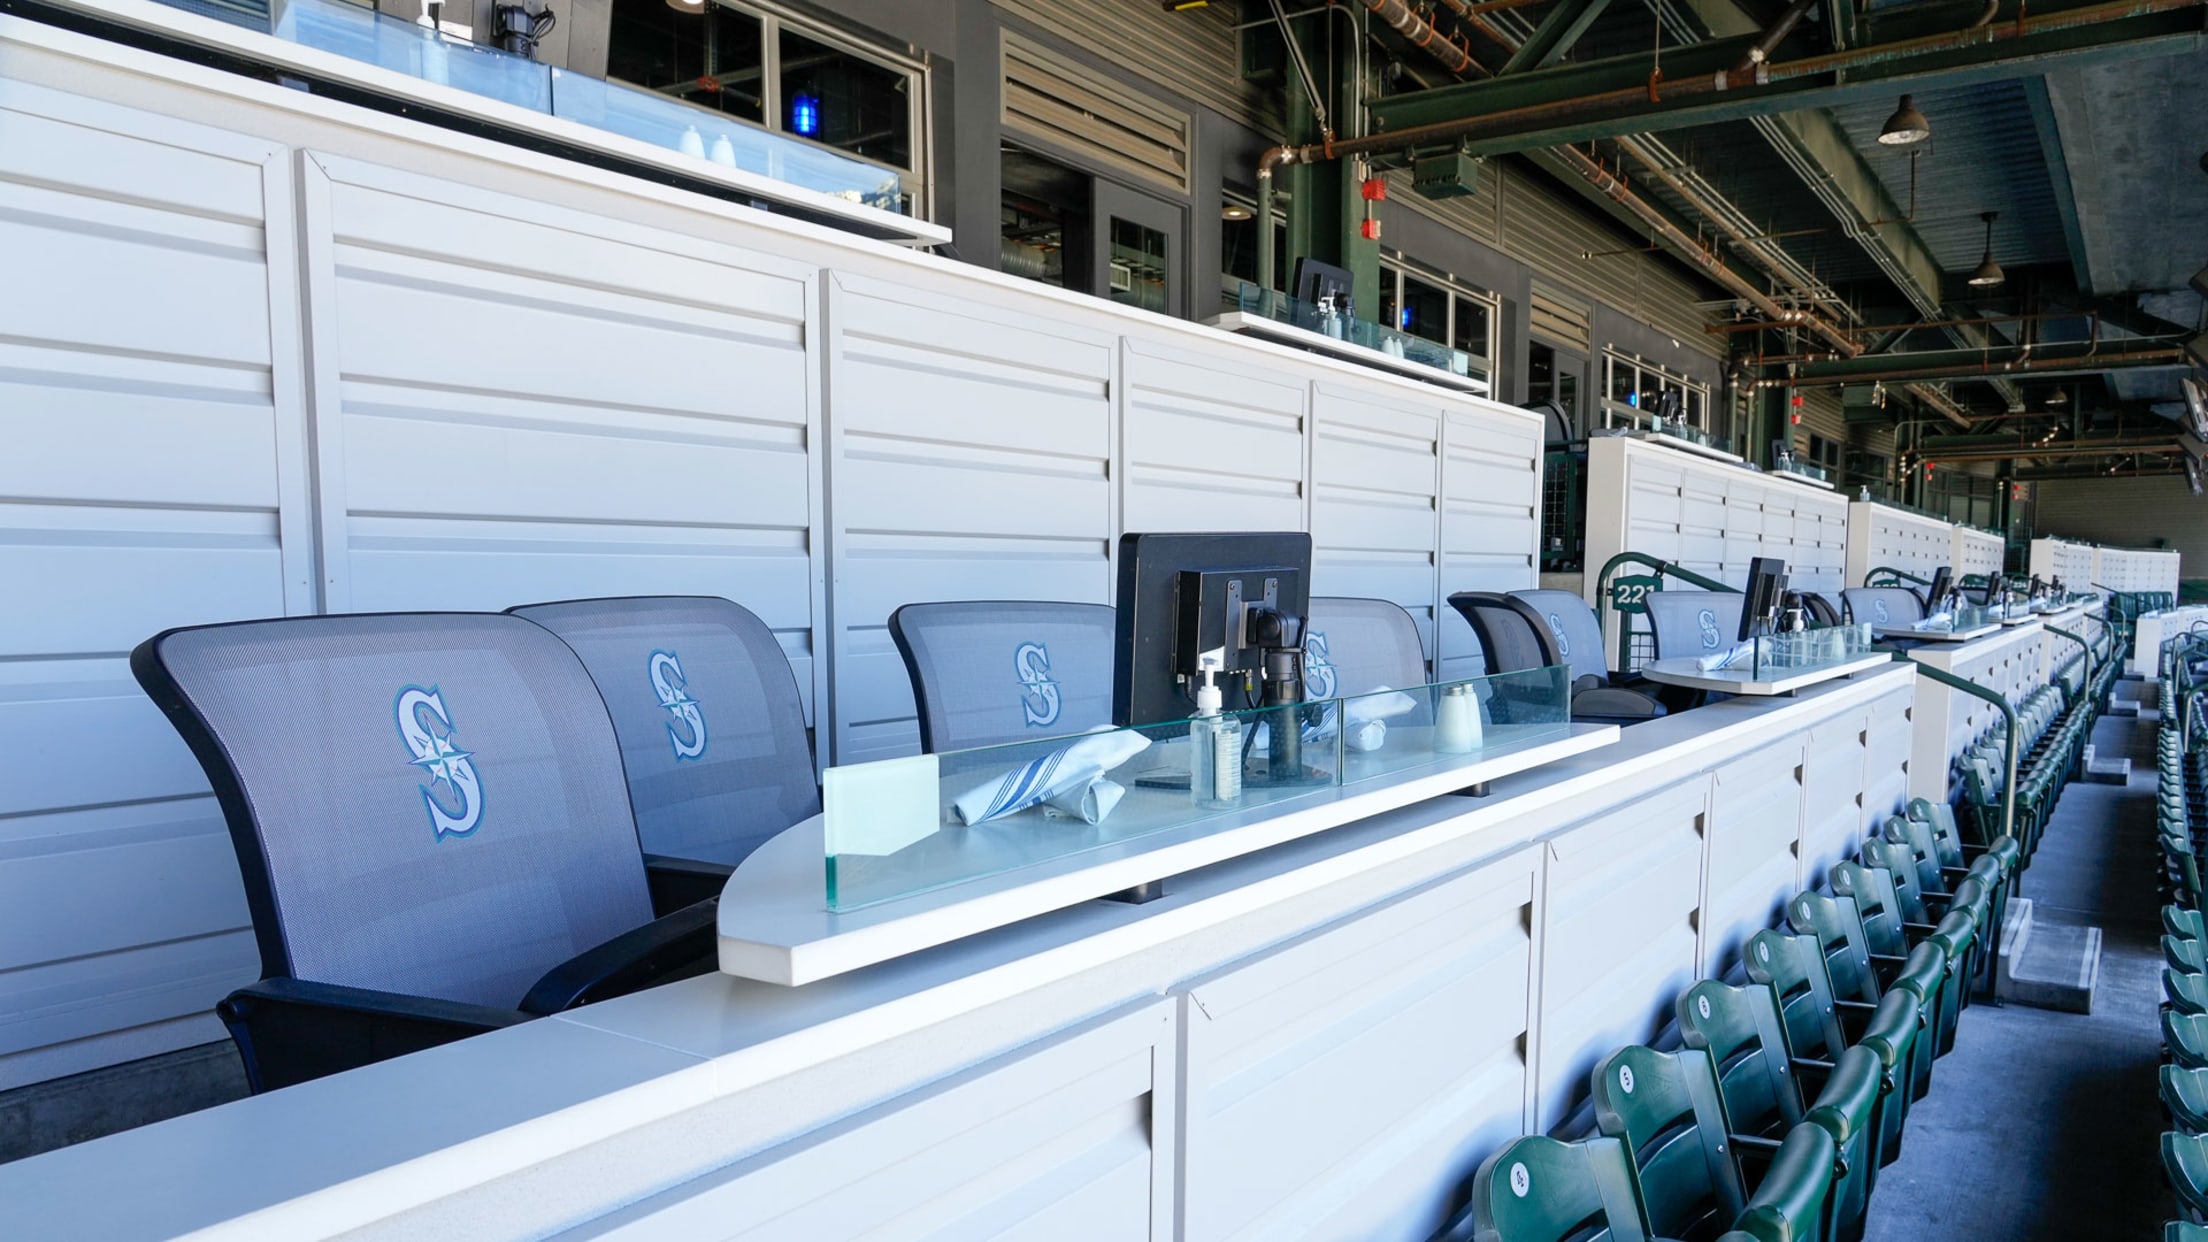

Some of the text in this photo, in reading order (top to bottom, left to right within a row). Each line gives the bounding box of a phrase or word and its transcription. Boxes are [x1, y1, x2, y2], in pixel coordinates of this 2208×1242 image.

[1698, 609, 1720, 650] S
[648, 649, 708, 763] S
[1015, 641, 1062, 728] S
[394, 683, 486, 844] S
